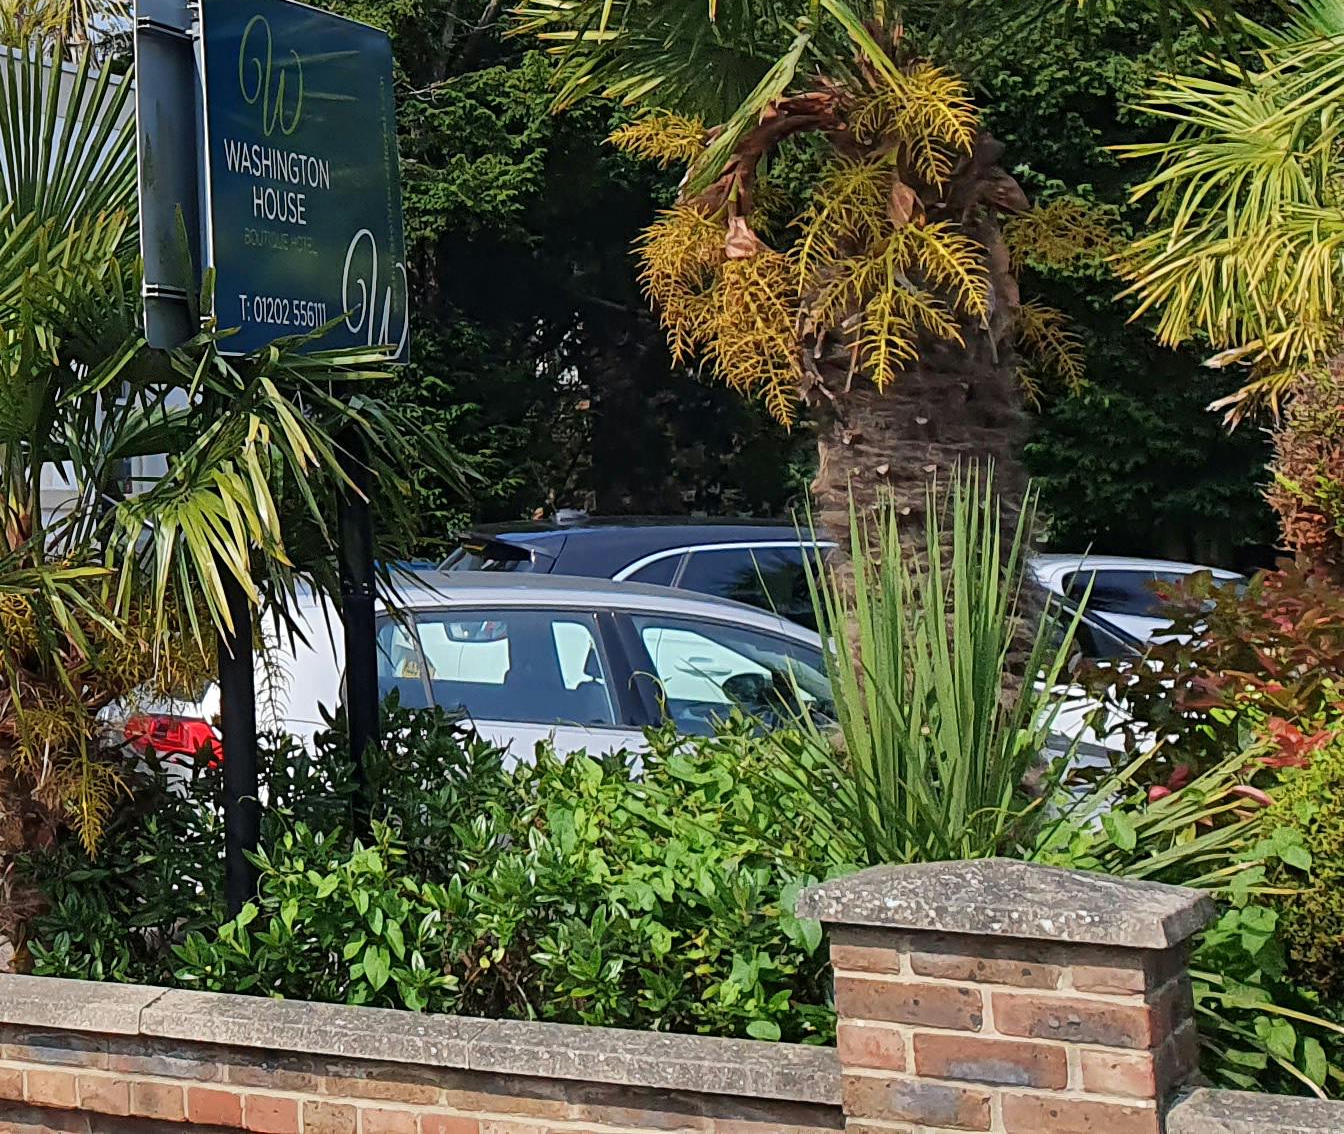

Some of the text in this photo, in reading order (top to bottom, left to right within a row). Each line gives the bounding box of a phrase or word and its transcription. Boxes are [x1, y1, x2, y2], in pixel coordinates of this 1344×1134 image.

[223, 138, 330, 190] WASHINGTON
[252, 186, 307, 225] HOUSE
[239, 294, 327, 328] T: 01202 556111
